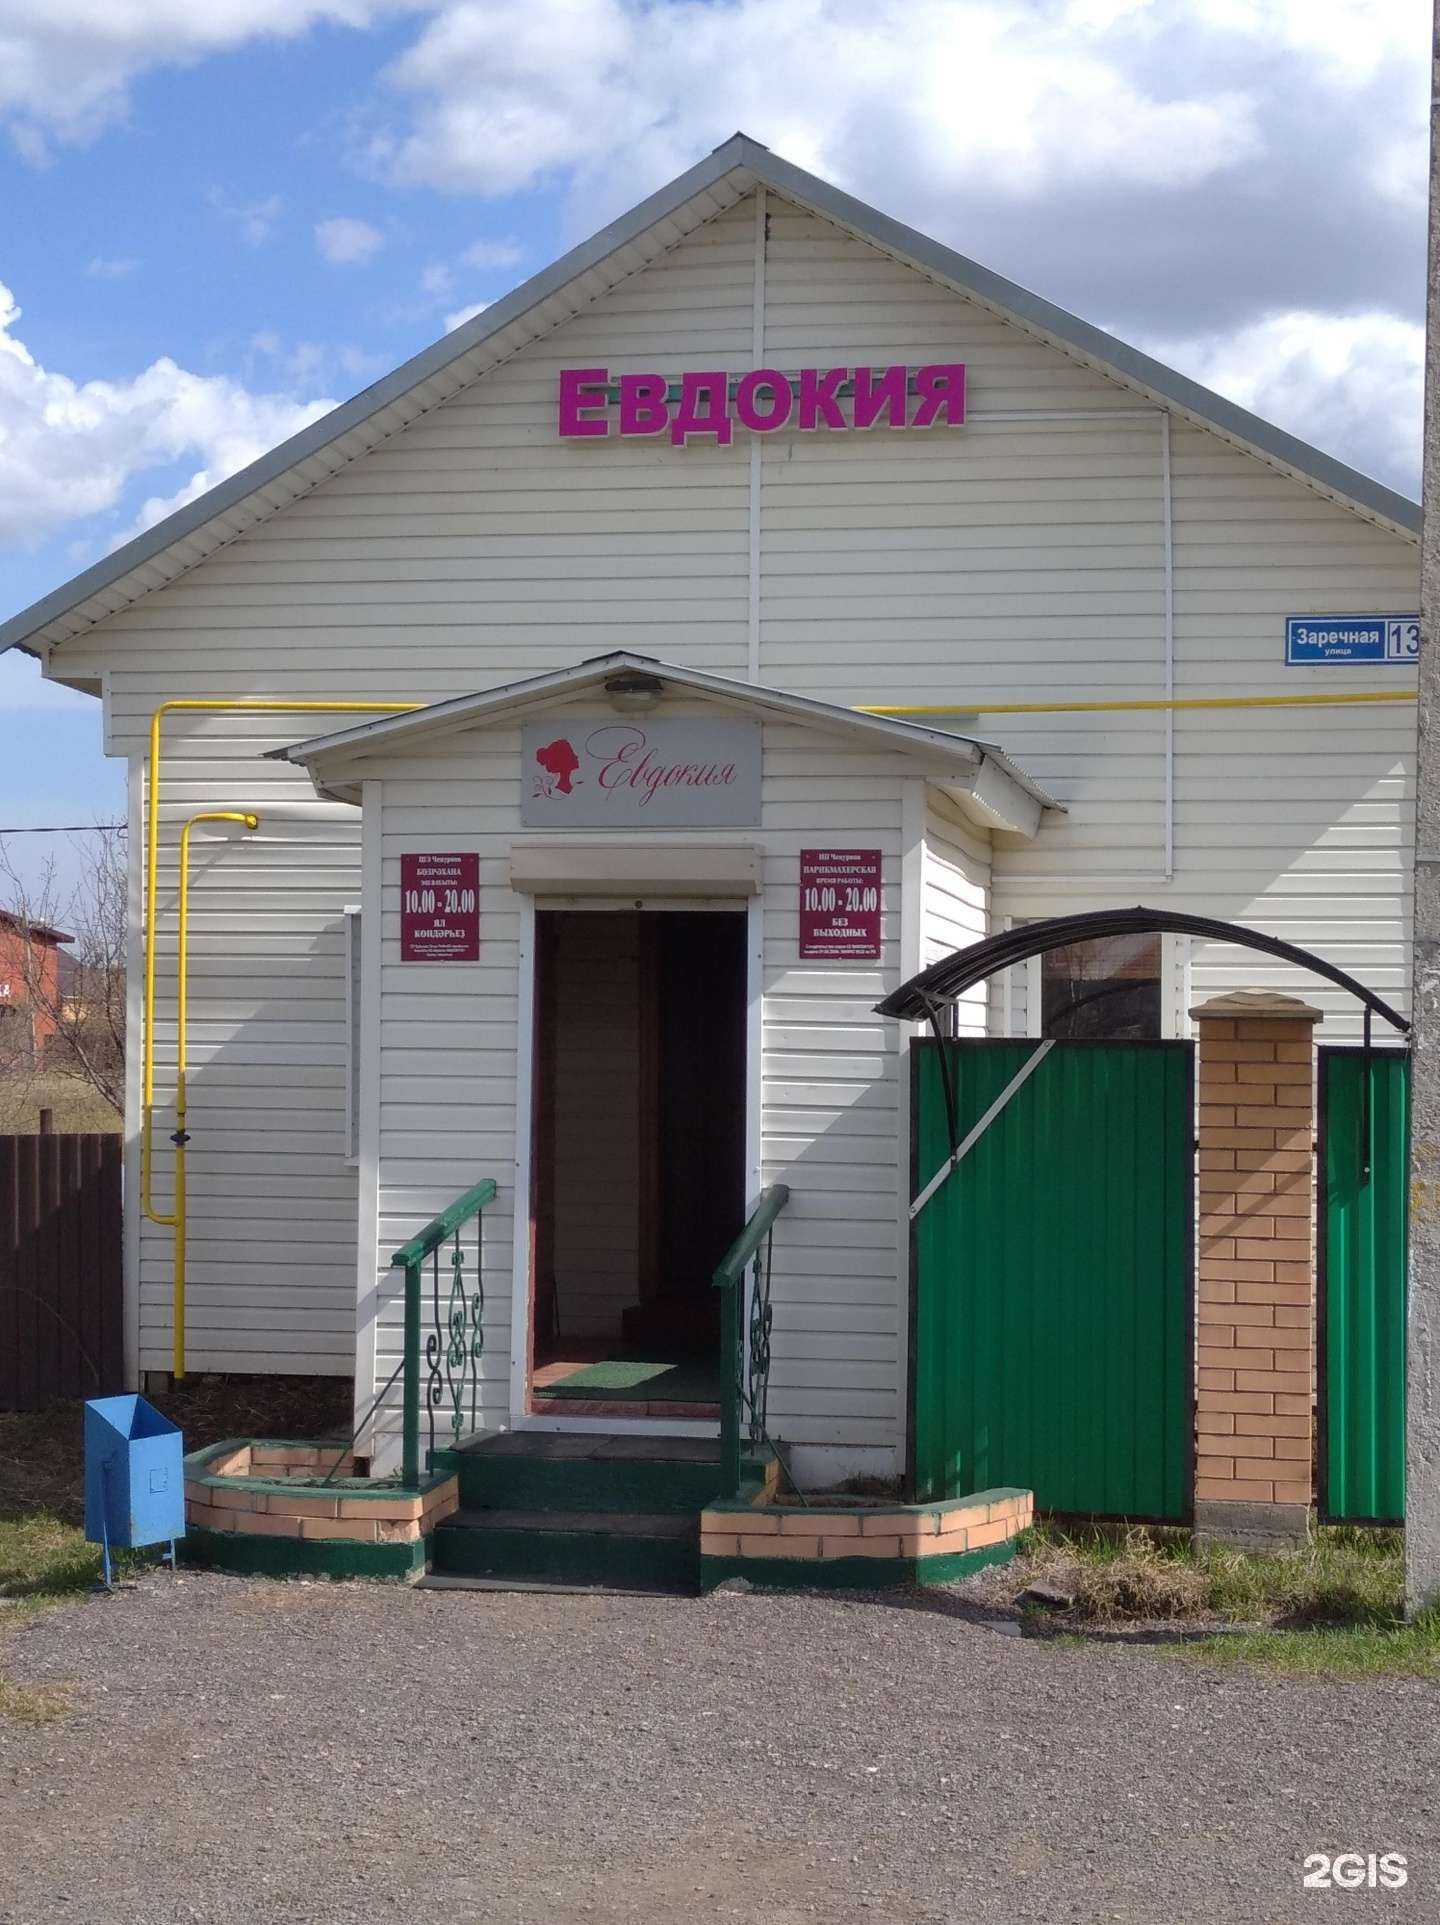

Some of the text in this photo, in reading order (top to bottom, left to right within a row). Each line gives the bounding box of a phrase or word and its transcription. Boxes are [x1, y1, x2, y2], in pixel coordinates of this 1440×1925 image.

[559, 363, 966, 447] ЕВДОКИЯ
[1297, 628, 1379, 648] Заречная
[1324, 648, 1352, 656] улица
[585, 726, 736, 807] Евдокия
[405, 889, 435, 913] 10.00
[444, 889, 475, 913] 20.00
[805, 887, 836, 912] 10.00
[845, 887, 877, 912] 20.00
[813, 928, 867, 937] ВЫХОДНЫХ
[832, 917, 848, 926] БЕЗ
